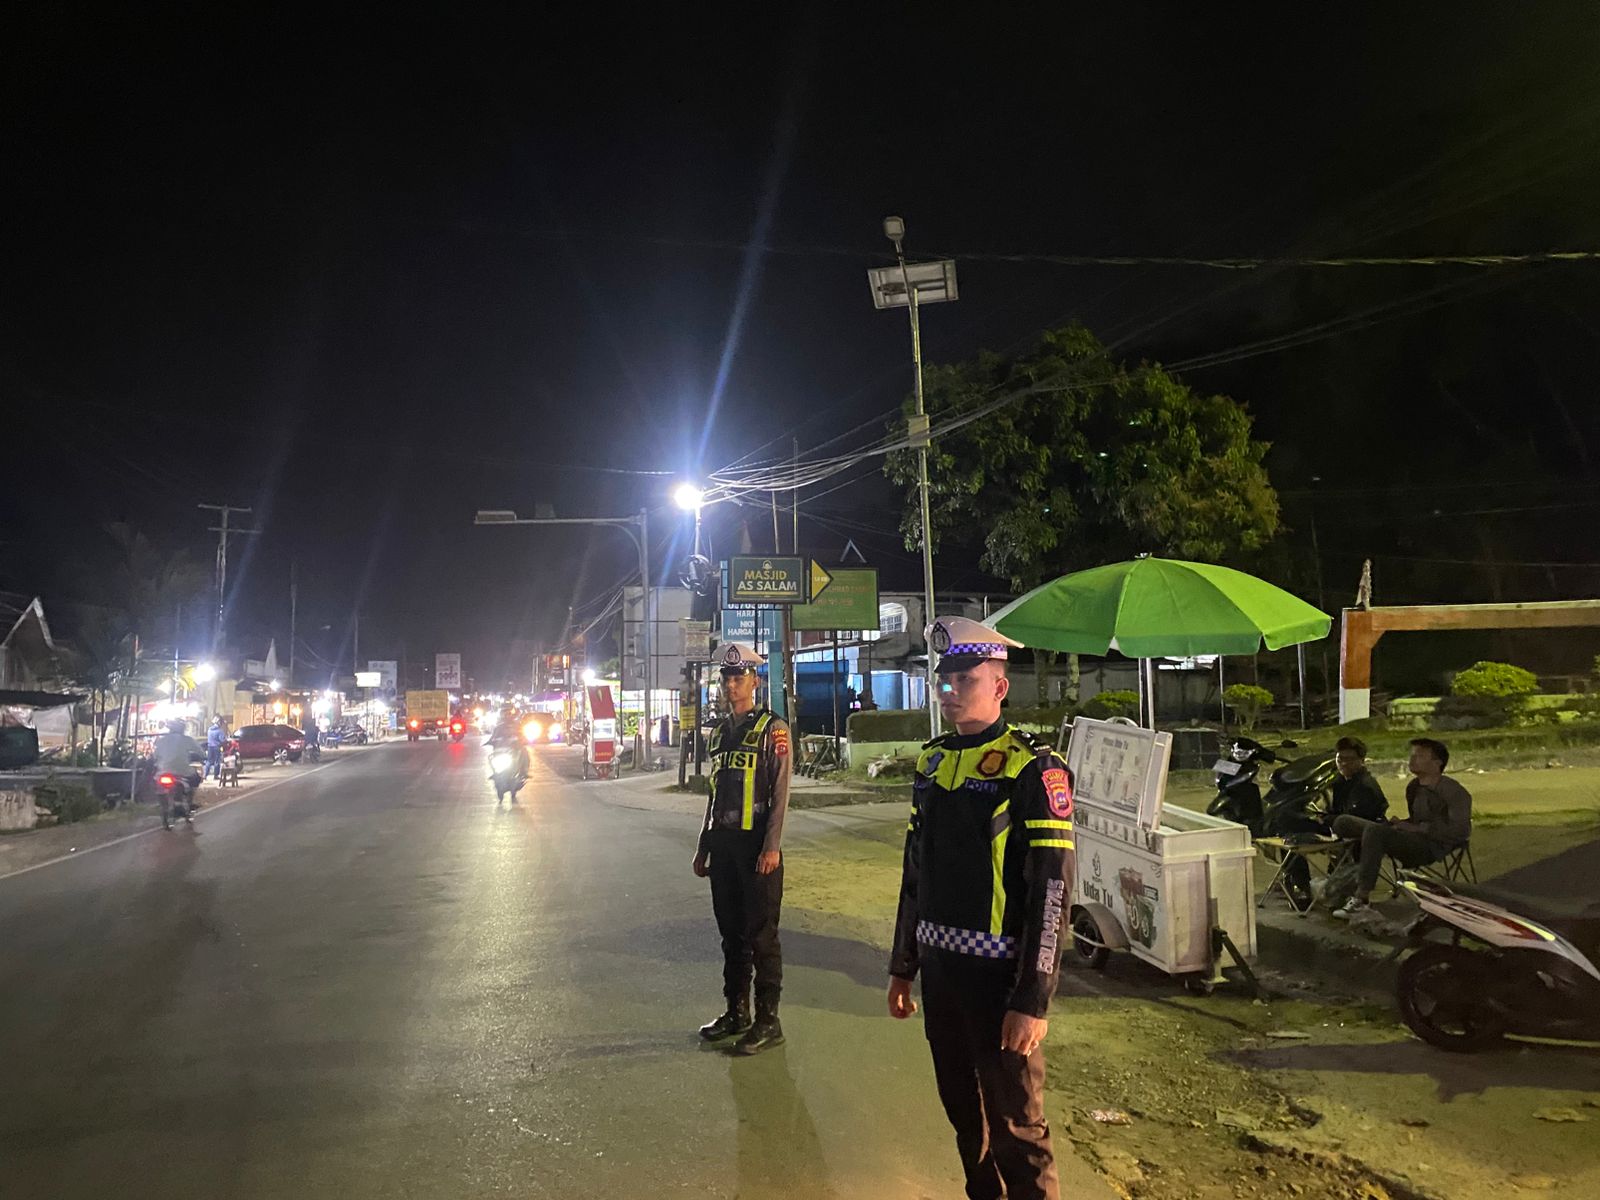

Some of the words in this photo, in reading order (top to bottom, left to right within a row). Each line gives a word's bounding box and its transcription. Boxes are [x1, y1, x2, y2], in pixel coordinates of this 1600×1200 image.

[744, 570, 787, 580] MASJID
[737, 581, 754, 591] AS
[758, 581, 797, 591] SALAM
